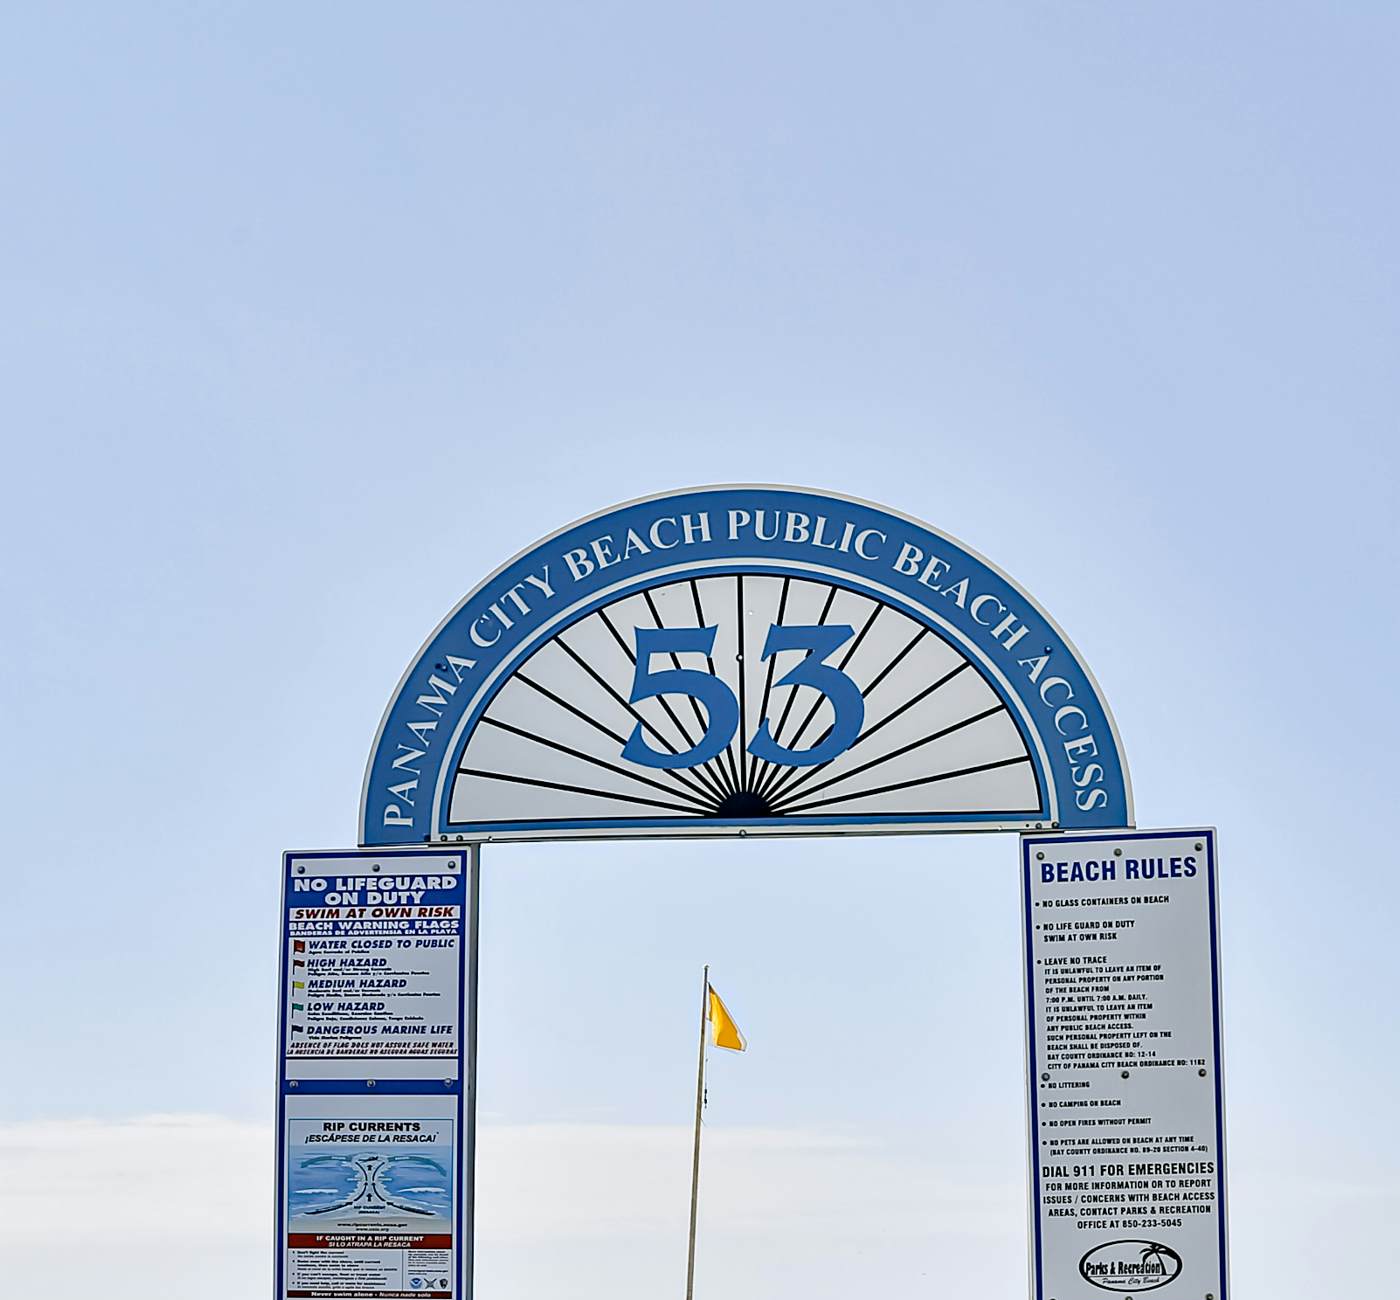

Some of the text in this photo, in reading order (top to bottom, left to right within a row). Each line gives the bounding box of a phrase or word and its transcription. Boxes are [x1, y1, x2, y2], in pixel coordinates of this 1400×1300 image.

[384, 509, 1107, 827] PANAMA CITY BEACH PUBLIC BEACH ACCESS
[621, 624, 867, 769] 53
[1041, 857, 1197, 883] BEACH RULES
[294, 877, 457, 891] NO LIFEGUARD
[325, 892, 425, 905] ON DUTY
[1043, 900, 1053, 908] NO
[1056, 899, 1079, 907] GLASS
[1082, 898, 1128, 906] CONTAINERS
[1144, 896, 1169, 904] BEACH
[295, 907, 454, 918] SWIM AT OWN RISK
[289, 920, 459, 930] BEACH WARNING FLAGS
[1075, 921, 1100, 929] GUARD
[1115, 920, 1135, 928] DUTY
[309, 939, 454, 949] WATER CLOSED TO PUBLIC
[307, 959, 386, 967] HIGH HAZARD
[1083, 956, 1107, 964] TRACE
[308, 980, 355, 988] MEDIUM
[307, 1003, 333, 1011] LOW
[307, 1026, 453, 1034] DANGEROUS MARINE LIFE
[323, 1123, 420, 1131] RIP CURRENTS
[1042, 1162, 1214, 1178] DIAL 911 FOR EMERGENCIES
[1046, 1183, 1062, 1191] FOR
[1065, 1182, 1088, 1190] MORE
[1092, 1181, 1148, 1190] INFORMATION
[1179, 1179, 1211, 1187] REPORT
[1043, 1196, 1072, 1204] ISSUES
[1081, 1195, 1125, 1203] CONCERNS
[1128, 1194, 1150, 1202] WITH
[1152, 1193, 1179, 1201] BEACH
[1182, 1192, 1215, 1200] ACCESS
[1049, 1209, 1077, 1217] AREAS,
[1080, 1207, 1118, 1216] CONTACT
[1121, 1207, 1147, 1215] PARKS
[1159, 1205, 1211, 1214] RECREATION
[1077, 1221, 1107, 1229] OFFICE
[1123, 1219, 1182, 1228] 850-233-5045
[1086, 1262, 1160, 1275] Parks & Recreation
